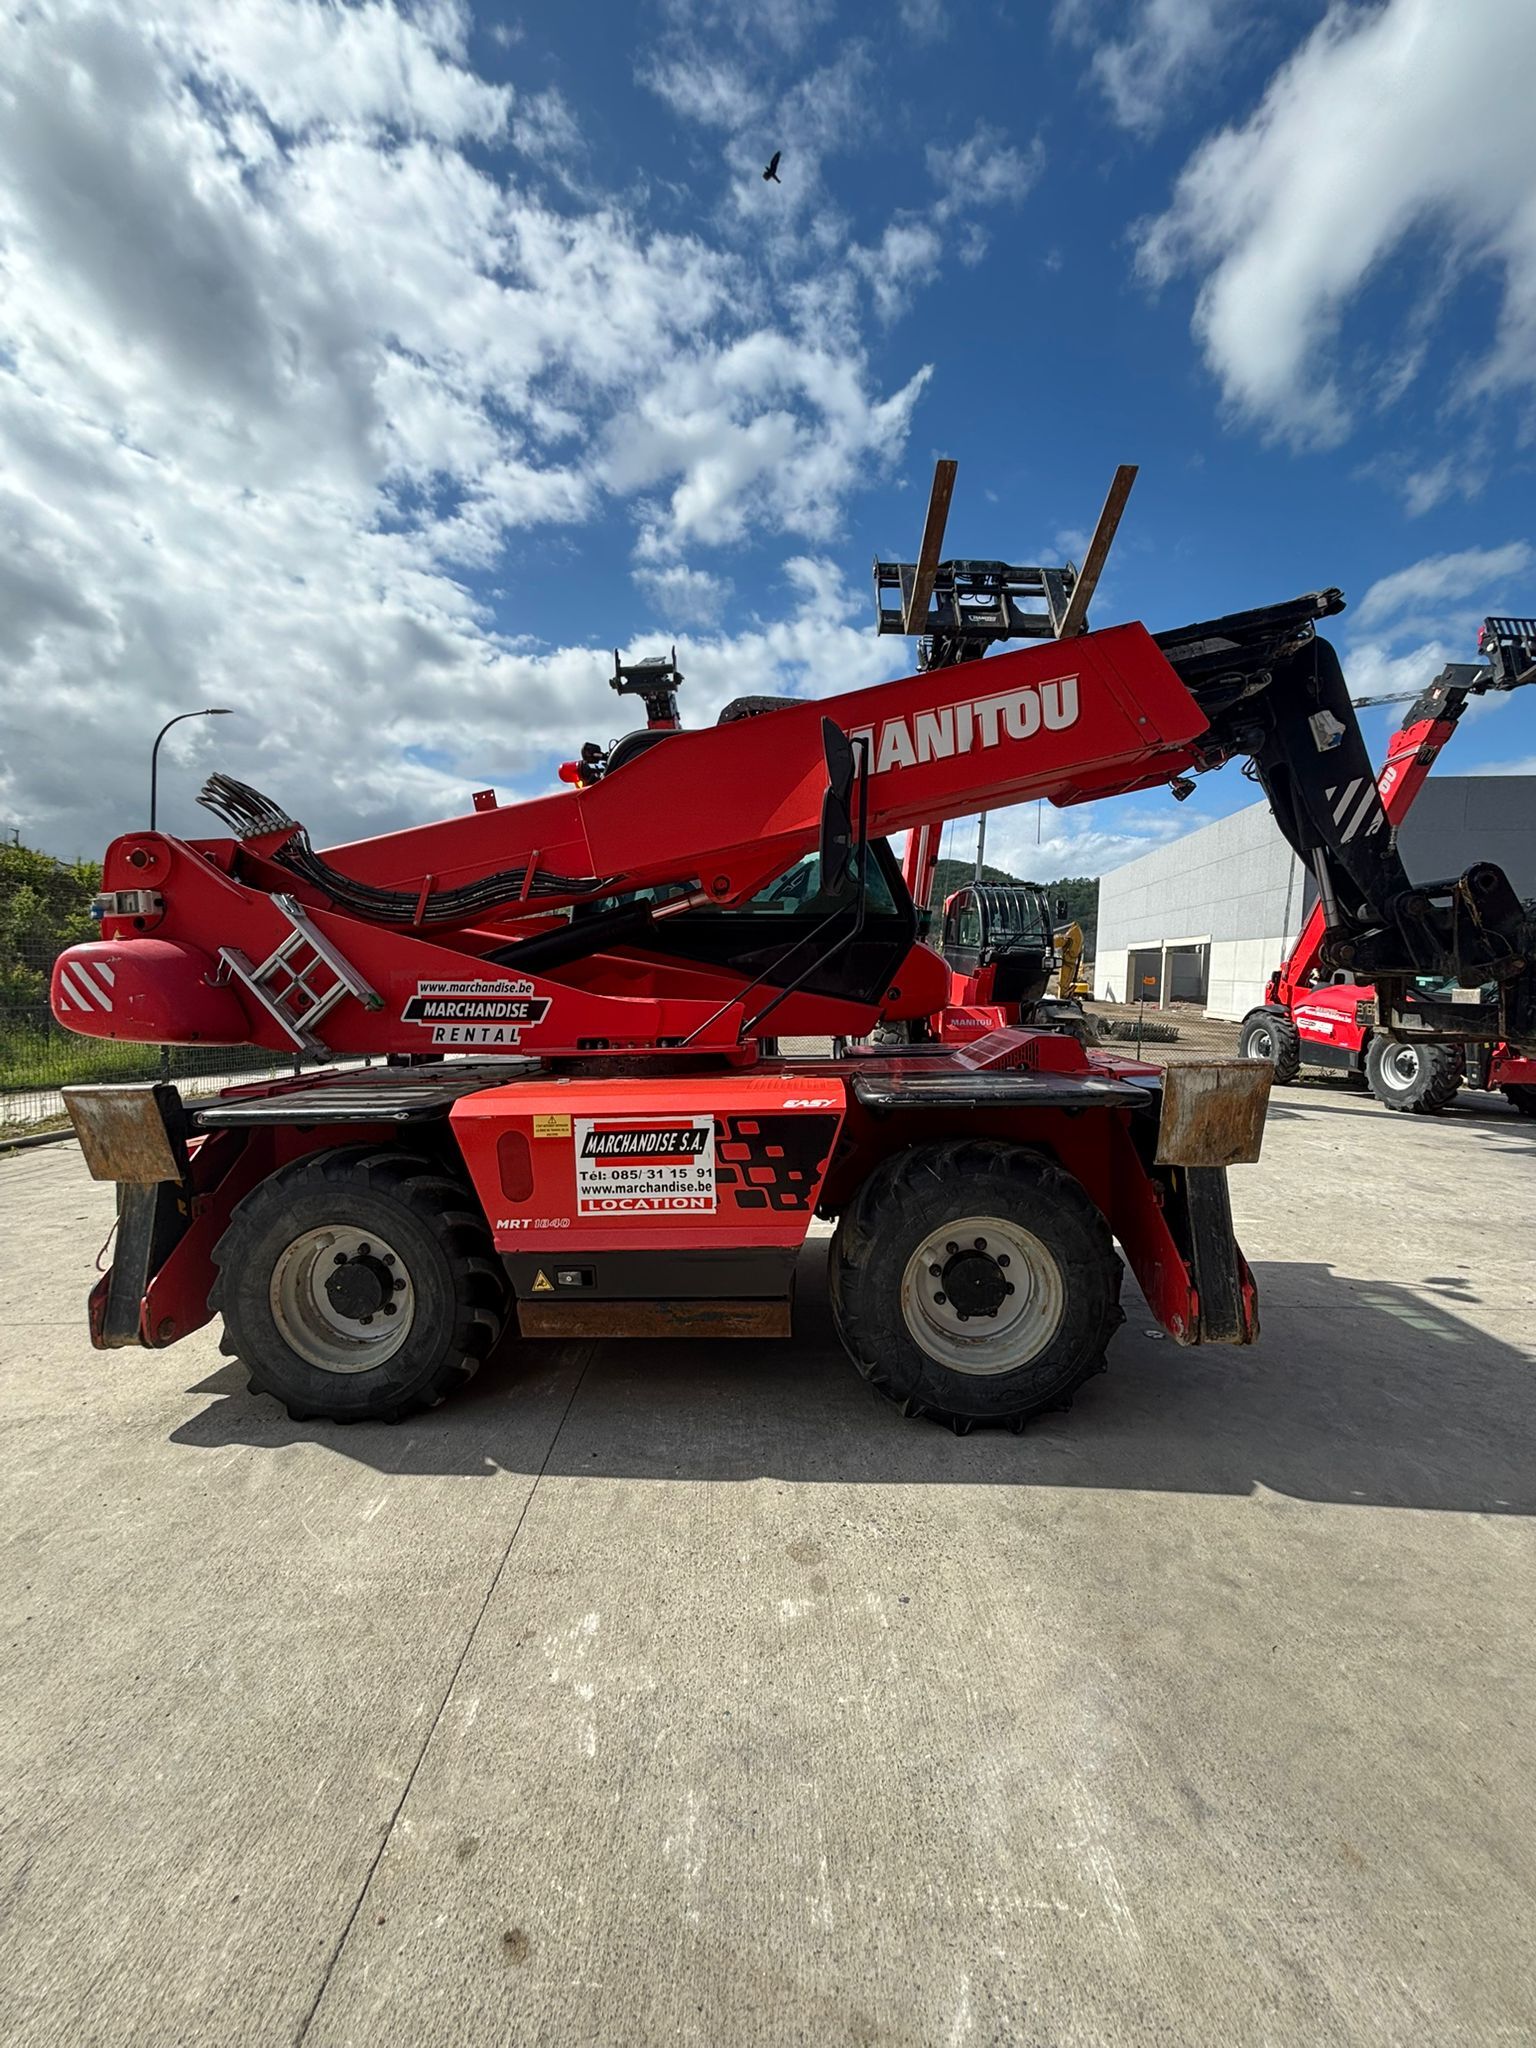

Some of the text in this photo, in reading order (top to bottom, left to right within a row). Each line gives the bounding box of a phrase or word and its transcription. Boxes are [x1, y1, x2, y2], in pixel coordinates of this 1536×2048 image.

[420, 983, 532, 993] www.marchandise.be
[424, 1002, 529, 1017] MARCHANDISE
[435, 1027, 518, 1042] RENTAL
[585, 1132, 703, 1154] MARCHANDISE S.A.
[579, 1168, 713, 1180] Tél: 085/ 31 15 91
[581, 1181, 712, 1195] www.marchandise.be
[588, 1198, 705, 1211] LOCATION
[496, 1217, 571, 1229] MRT 1840
